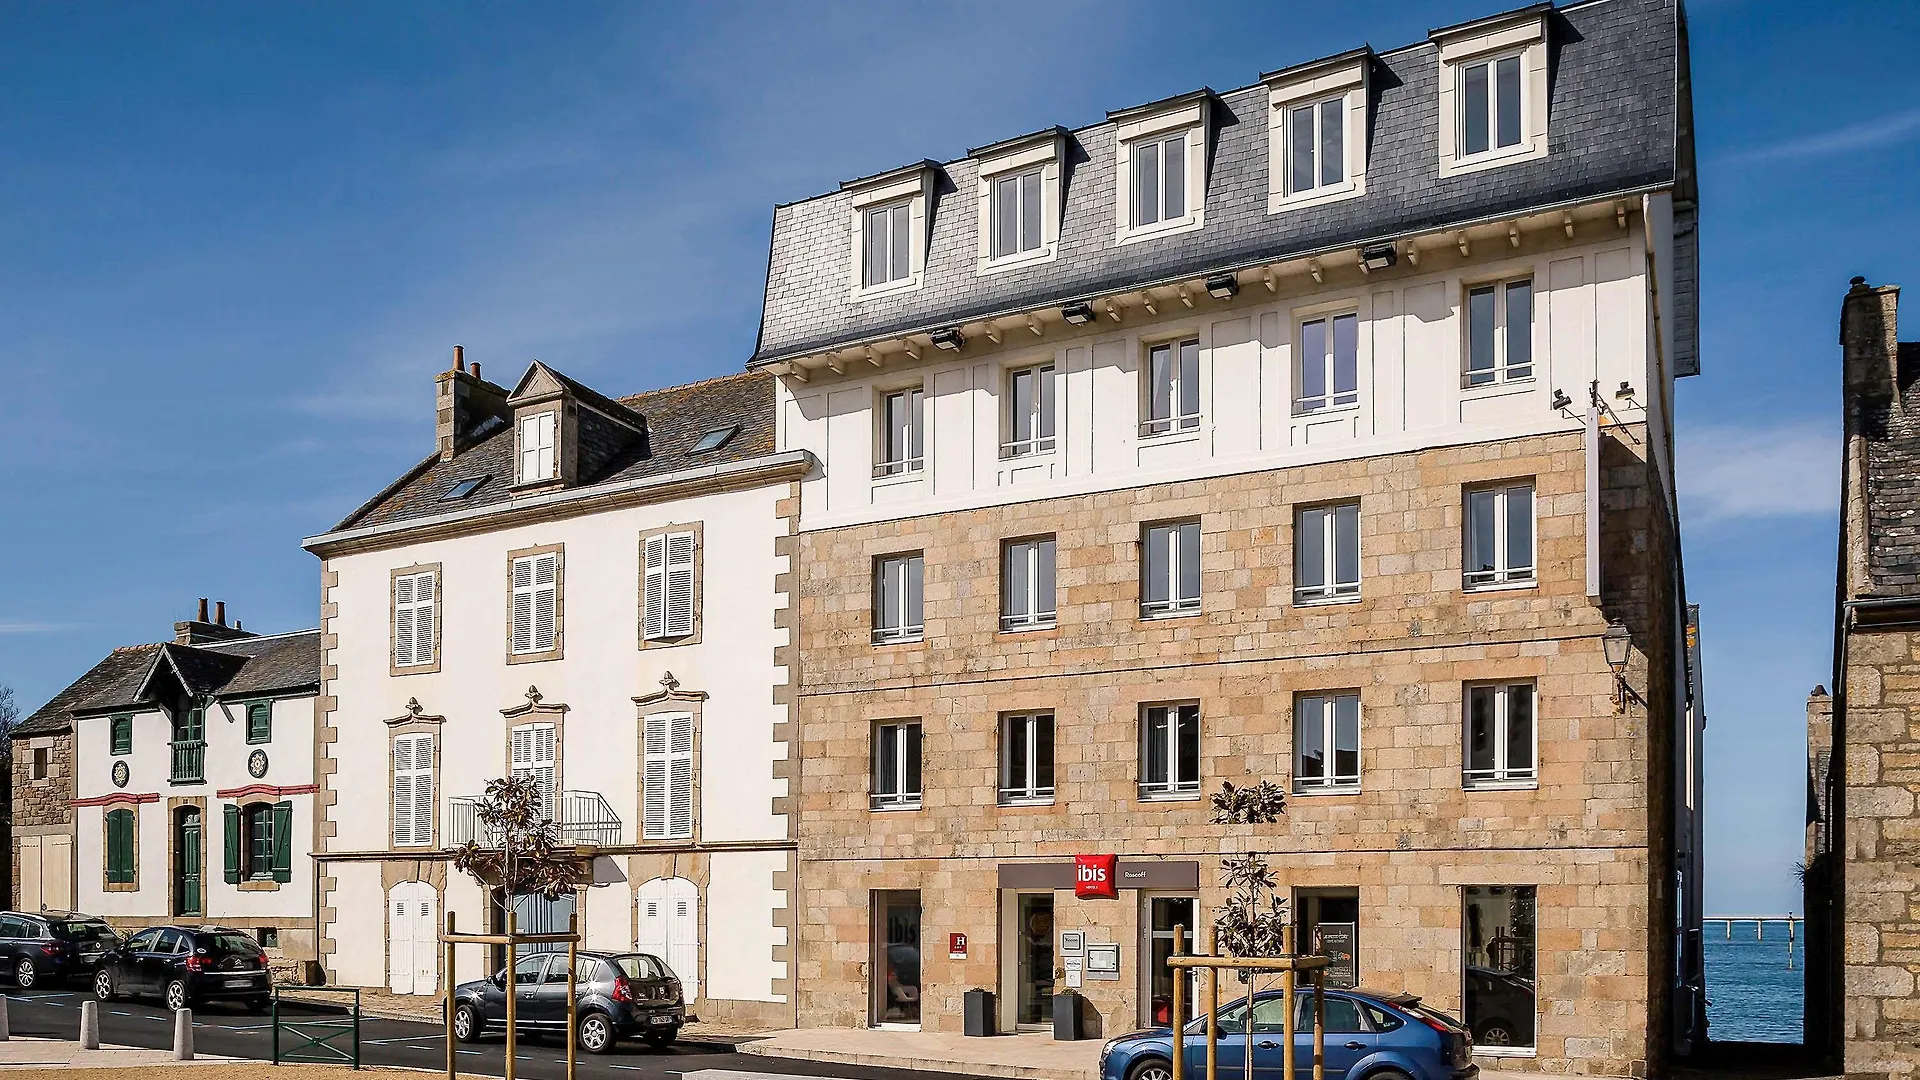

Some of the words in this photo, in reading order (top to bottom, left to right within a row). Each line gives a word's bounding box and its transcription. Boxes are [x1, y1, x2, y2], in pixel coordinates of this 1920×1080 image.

[1077, 864, 1107, 882] ibis
[1124, 871, 1147, 879] Roscoff
[956, 936, 966, 946] H
